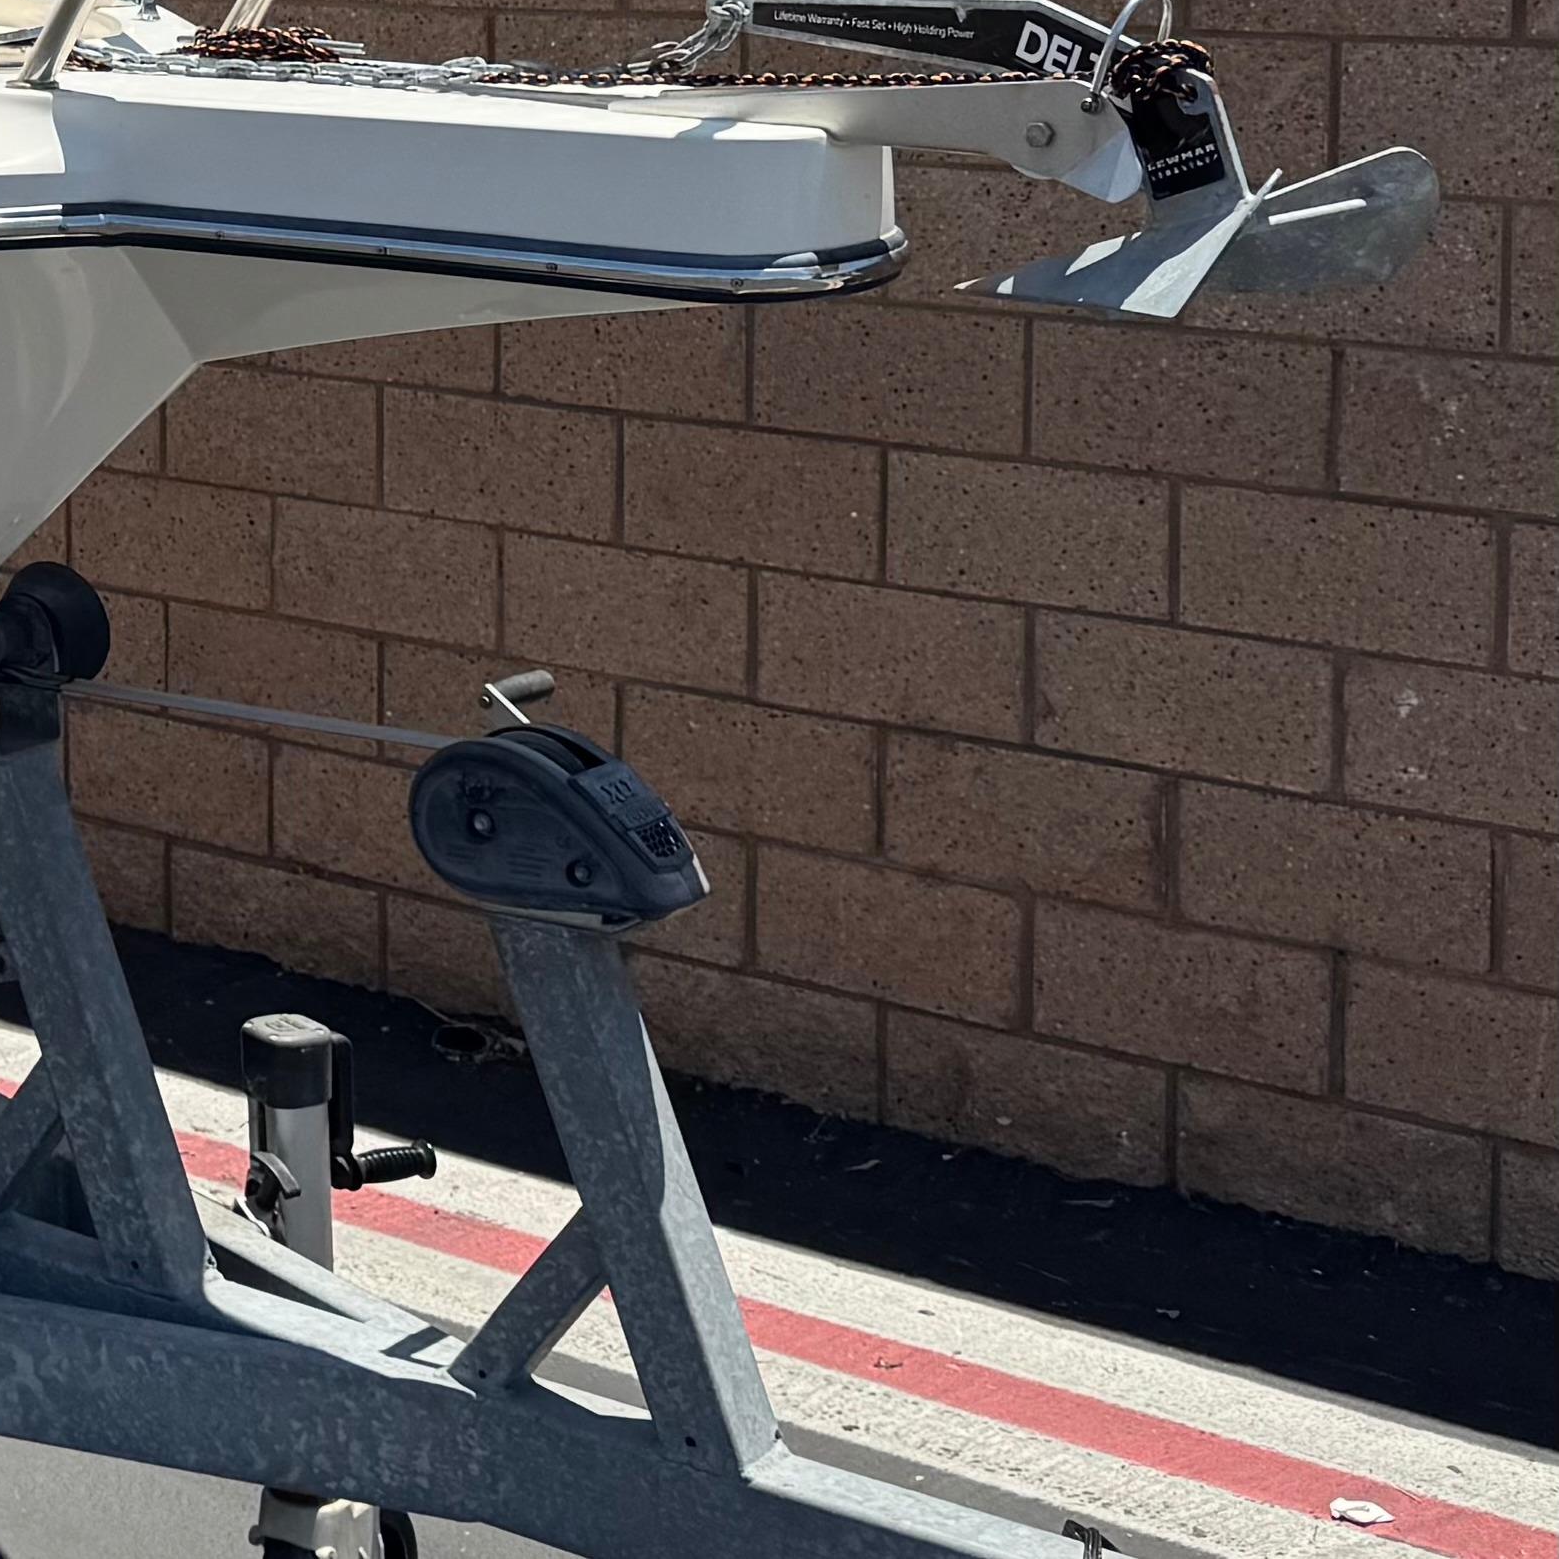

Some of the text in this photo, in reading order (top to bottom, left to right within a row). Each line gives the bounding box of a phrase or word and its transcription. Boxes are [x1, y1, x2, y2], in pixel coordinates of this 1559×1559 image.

[773, 10, 975, 38] Lifetime Warranty Fast Set High Holding Power
[1147, 143, 1215, 171] LEWMAR
